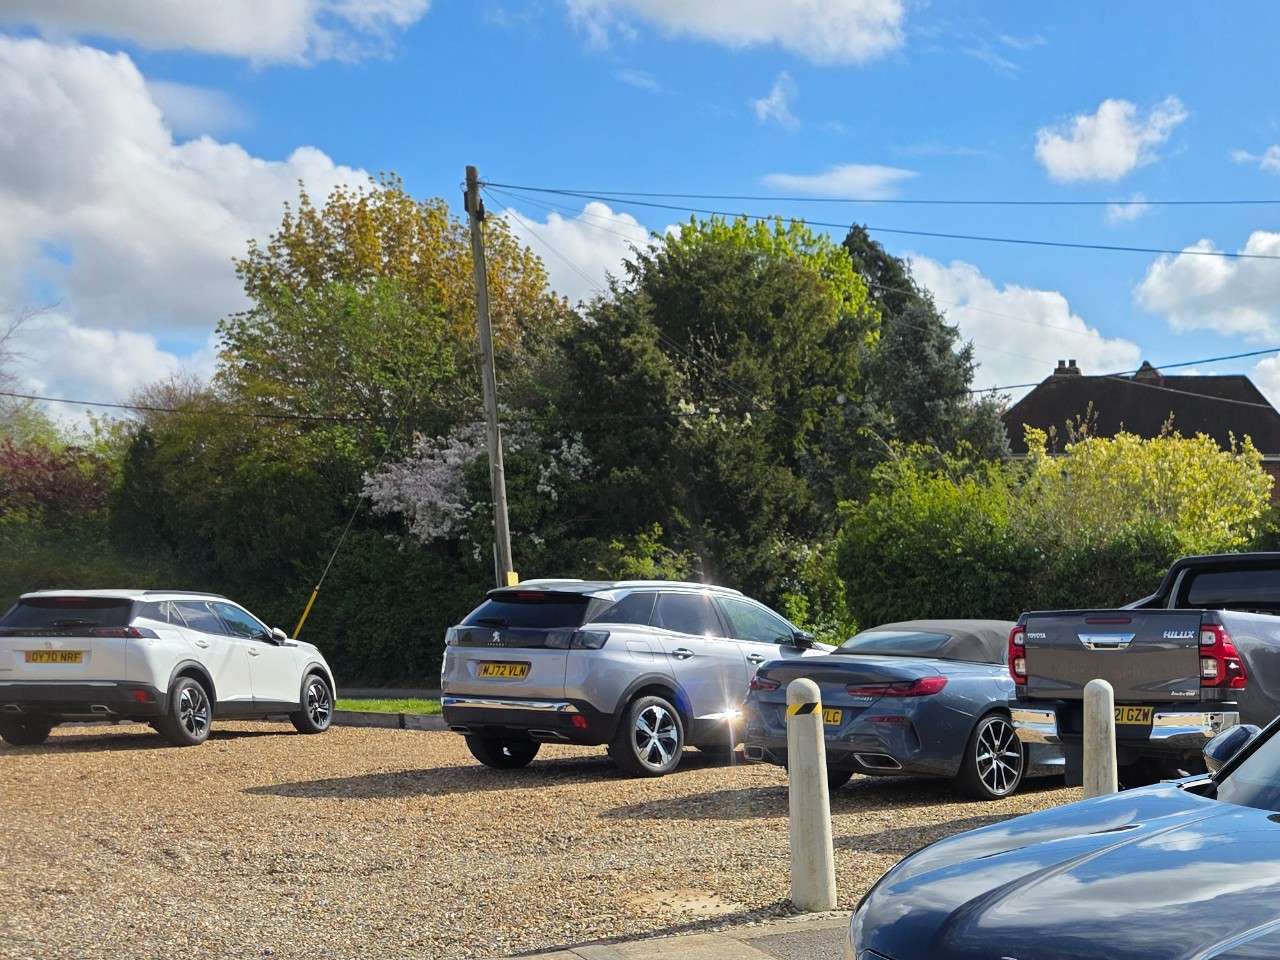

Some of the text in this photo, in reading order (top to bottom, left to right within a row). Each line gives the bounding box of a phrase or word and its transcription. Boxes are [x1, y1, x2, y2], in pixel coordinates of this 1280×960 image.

[1163, 630, 1195, 638] HILUX
[1114, 708, 1150, 722] 21 GZW
